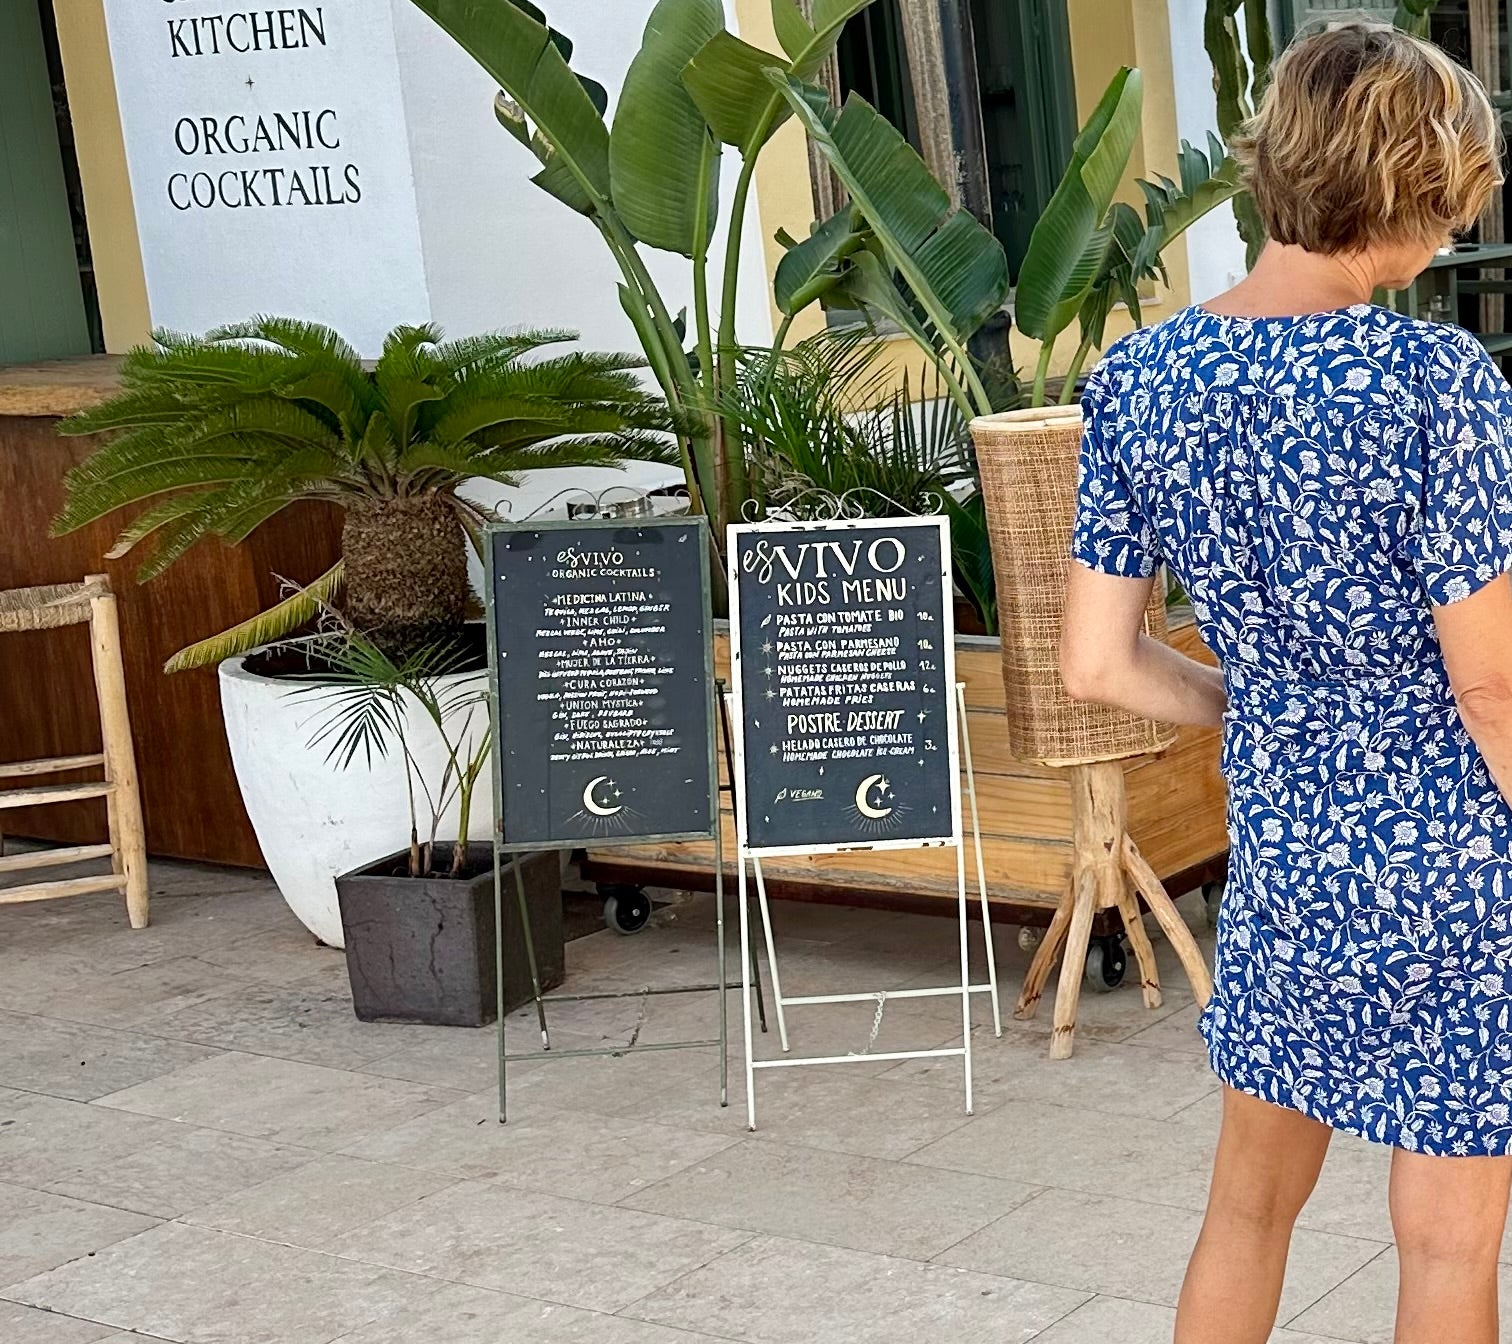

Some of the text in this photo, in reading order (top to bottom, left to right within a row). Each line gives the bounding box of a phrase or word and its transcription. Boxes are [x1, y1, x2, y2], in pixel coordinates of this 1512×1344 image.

[166, 7, 328, 59] KITCHEN
[173, 109, 341, 157] ORGANIC
[167, 165, 363, 212] COCKTAILS
[772, 537, 906, 580] VIVO
[551, 567, 655, 579] ORGANIC COCKTAILS
[556, 591, 647, 606] MEDICINA LATINA
[777, 577, 907, 607] KIDS MENU
[566, 614, 630, 628] INNER CHILD
[776, 608, 904, 626] PASTA CON TOMATE BIO
[778, 626, 805, 638] PASTA
[589, 637, 616, 648] AHO
[776, 636, 900, 652] PASTA CON PARMESANO
[560, 656, 616, 669] MUJER DE LA
[777, 663, 828, 676] NUGGETS
[830, 662, 869, 673] CASEROS
[870, 662, 882, 672] DE
[569, 679, 598, 690] CURA
[779, 680, 916, 698] PATATAS FRITAS CASERAS
[565, 699, 599, 711] UNION
[782, 693, 874, 708] HOMEMADE FRIES
[569, 718, 643, 731] FUEGO SAGRADO
[787, 709, 906, 735] POSTRE DESSERT
[576, 739, 641, 751] NATURALEZA
[781, 733, 913, 752] HELADO CASERO DE CHOCOLATE
